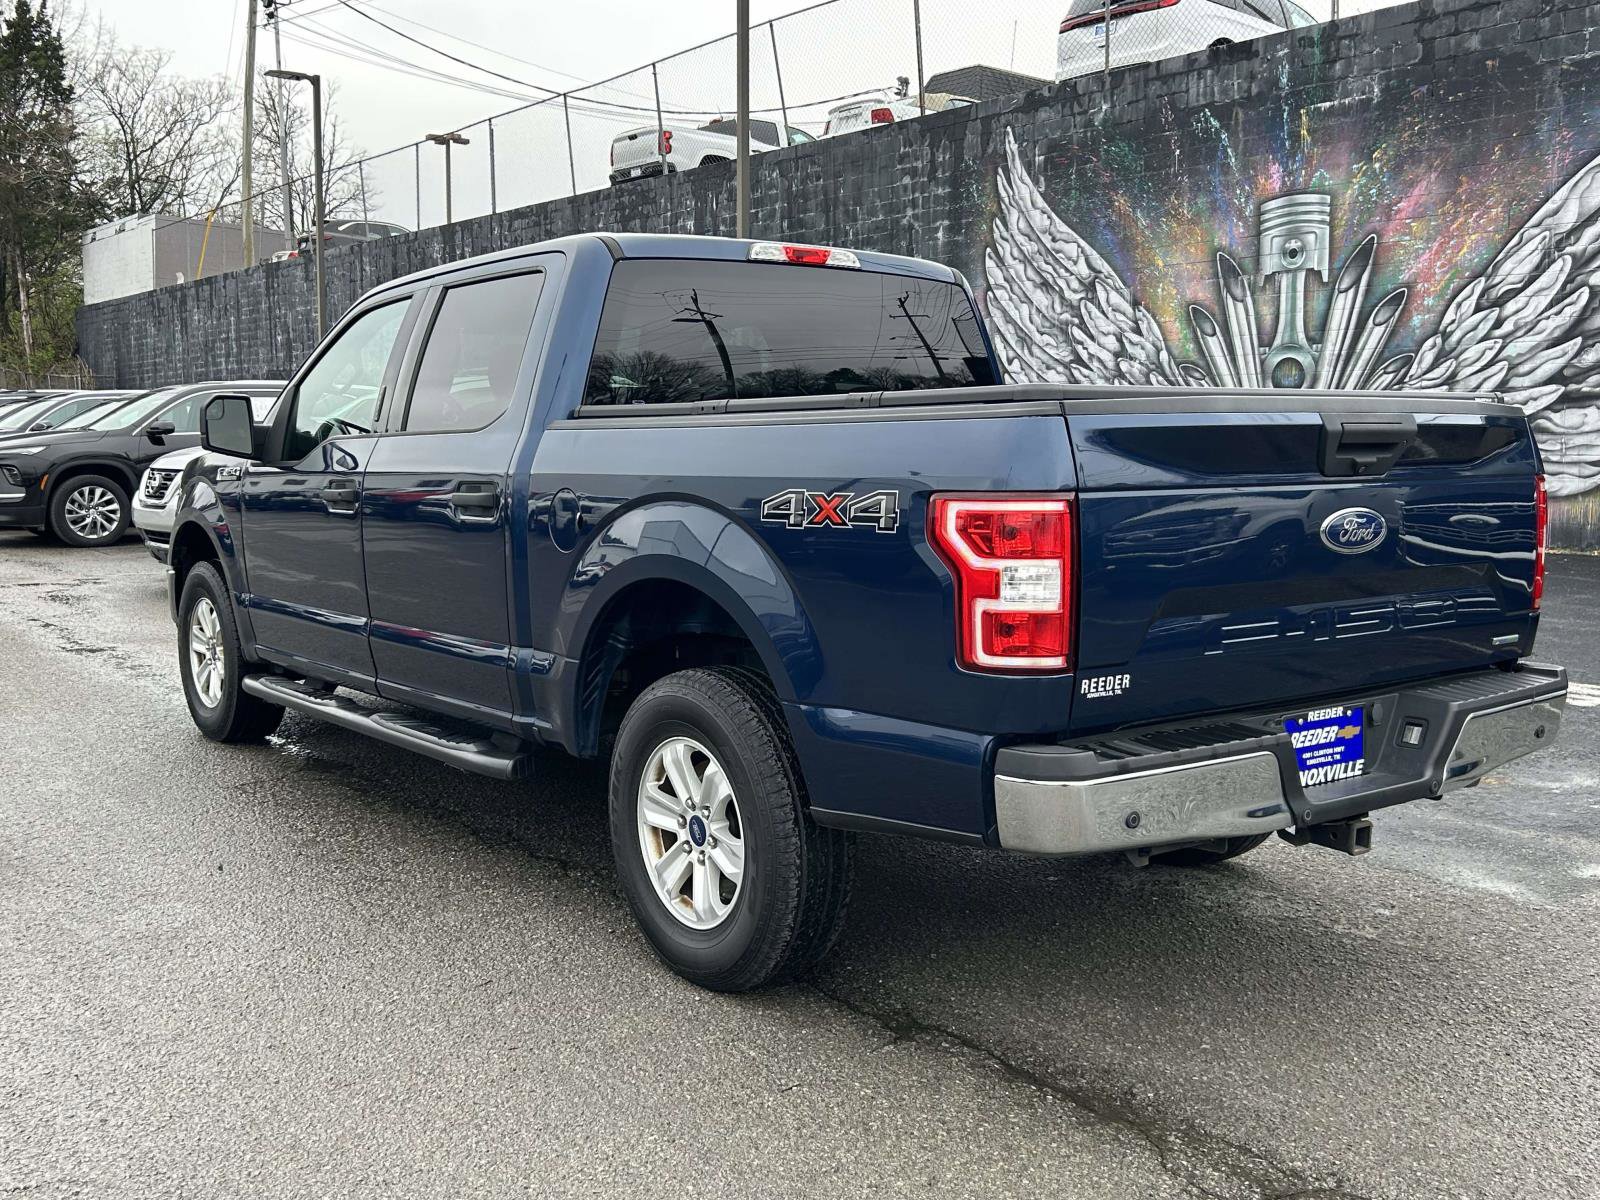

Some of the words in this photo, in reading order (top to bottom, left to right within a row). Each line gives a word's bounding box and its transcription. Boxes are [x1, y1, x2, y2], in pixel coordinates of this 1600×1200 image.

[1339, 517, 1376, 543] Ford
[1081, 674, 1130, 694] REEDER
[1308, 706, 1344, 722] REEDER
[1291, 725, 1339, 749] REEDER
[1299, 758, 1365, 787] NOXVILLE
